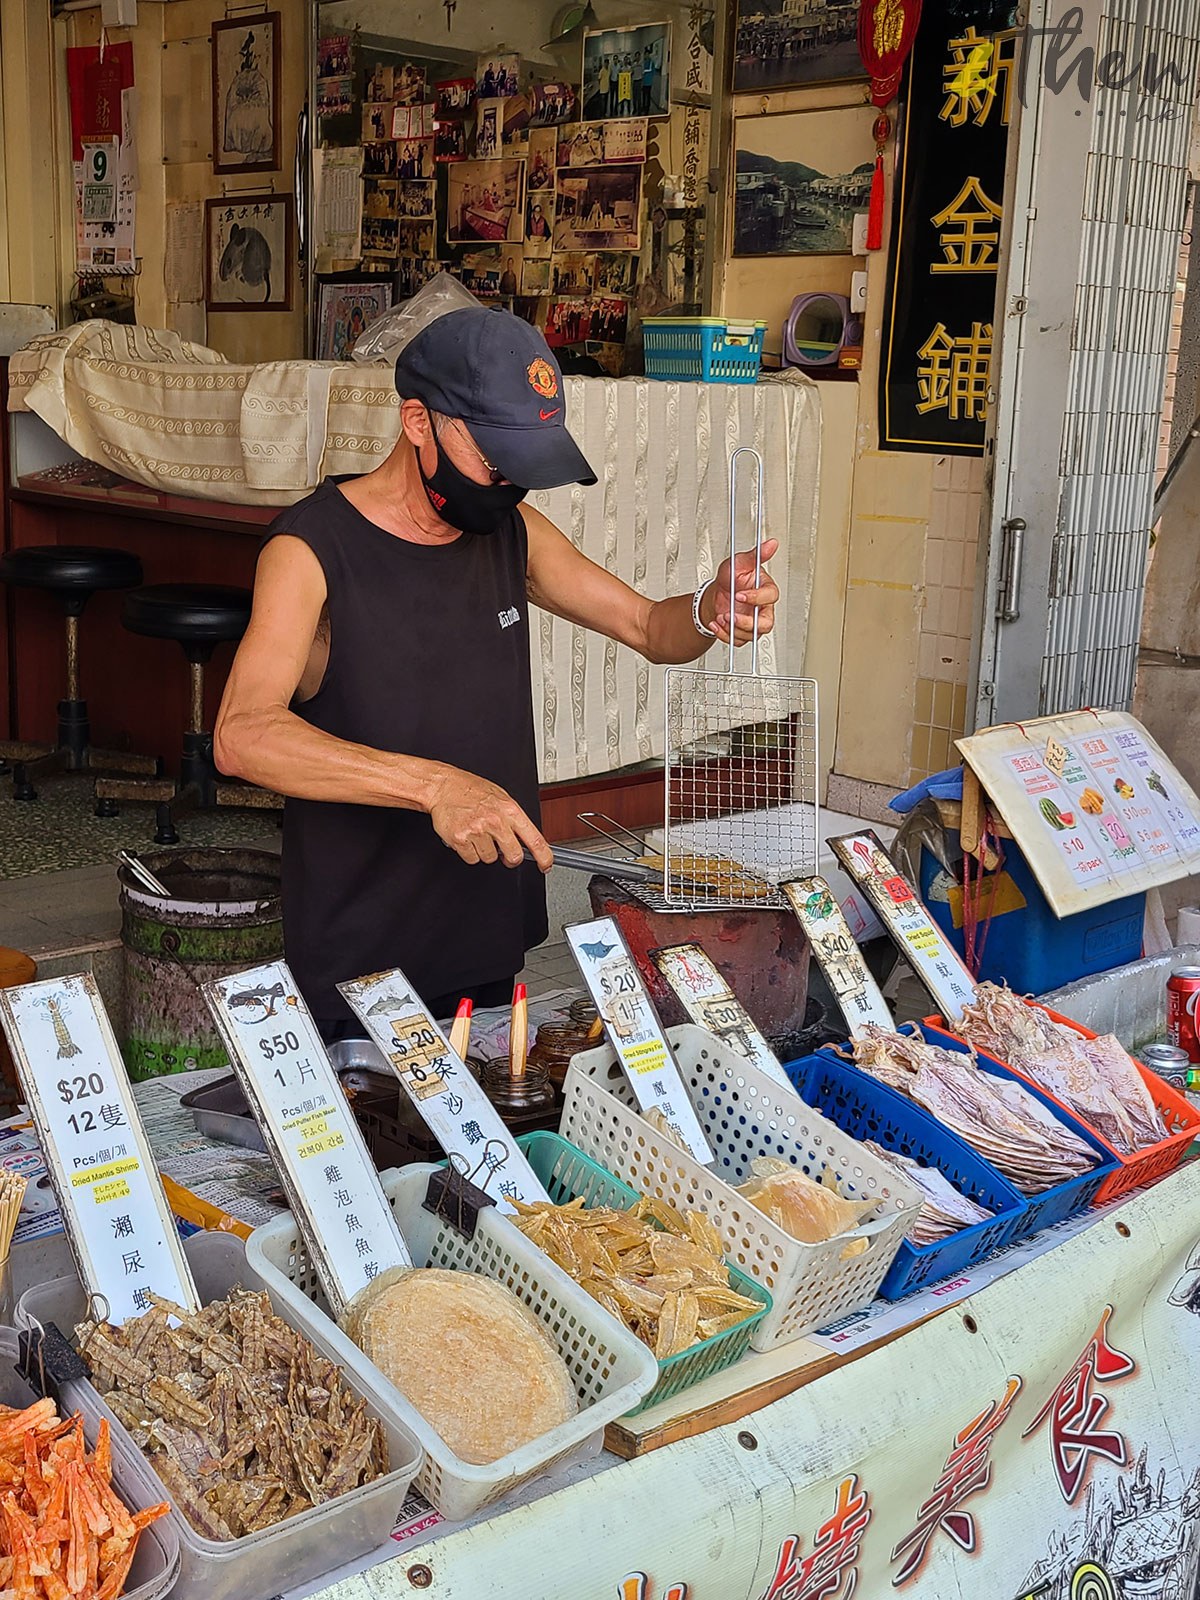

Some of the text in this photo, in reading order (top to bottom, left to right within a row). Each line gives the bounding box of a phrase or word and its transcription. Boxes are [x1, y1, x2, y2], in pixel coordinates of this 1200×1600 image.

[93, 150, 107, 181] 9
[889, 882, 909, 899] 50
[935, 961, 974, 1007] 魷魚
[258, 1030, 301, 1061] $50
[297, 1059, 318, 1085] 片
[57, 1072, 104, 1104] $20
[67, 1103, 127, 1135] 12隻
[281, 1121, 297, 1132] Dried
[71, 1162, 140, 1188] Dried Mantis Shrimp
[323, 1164, 379, 1281] 雞泡魚魚乾
